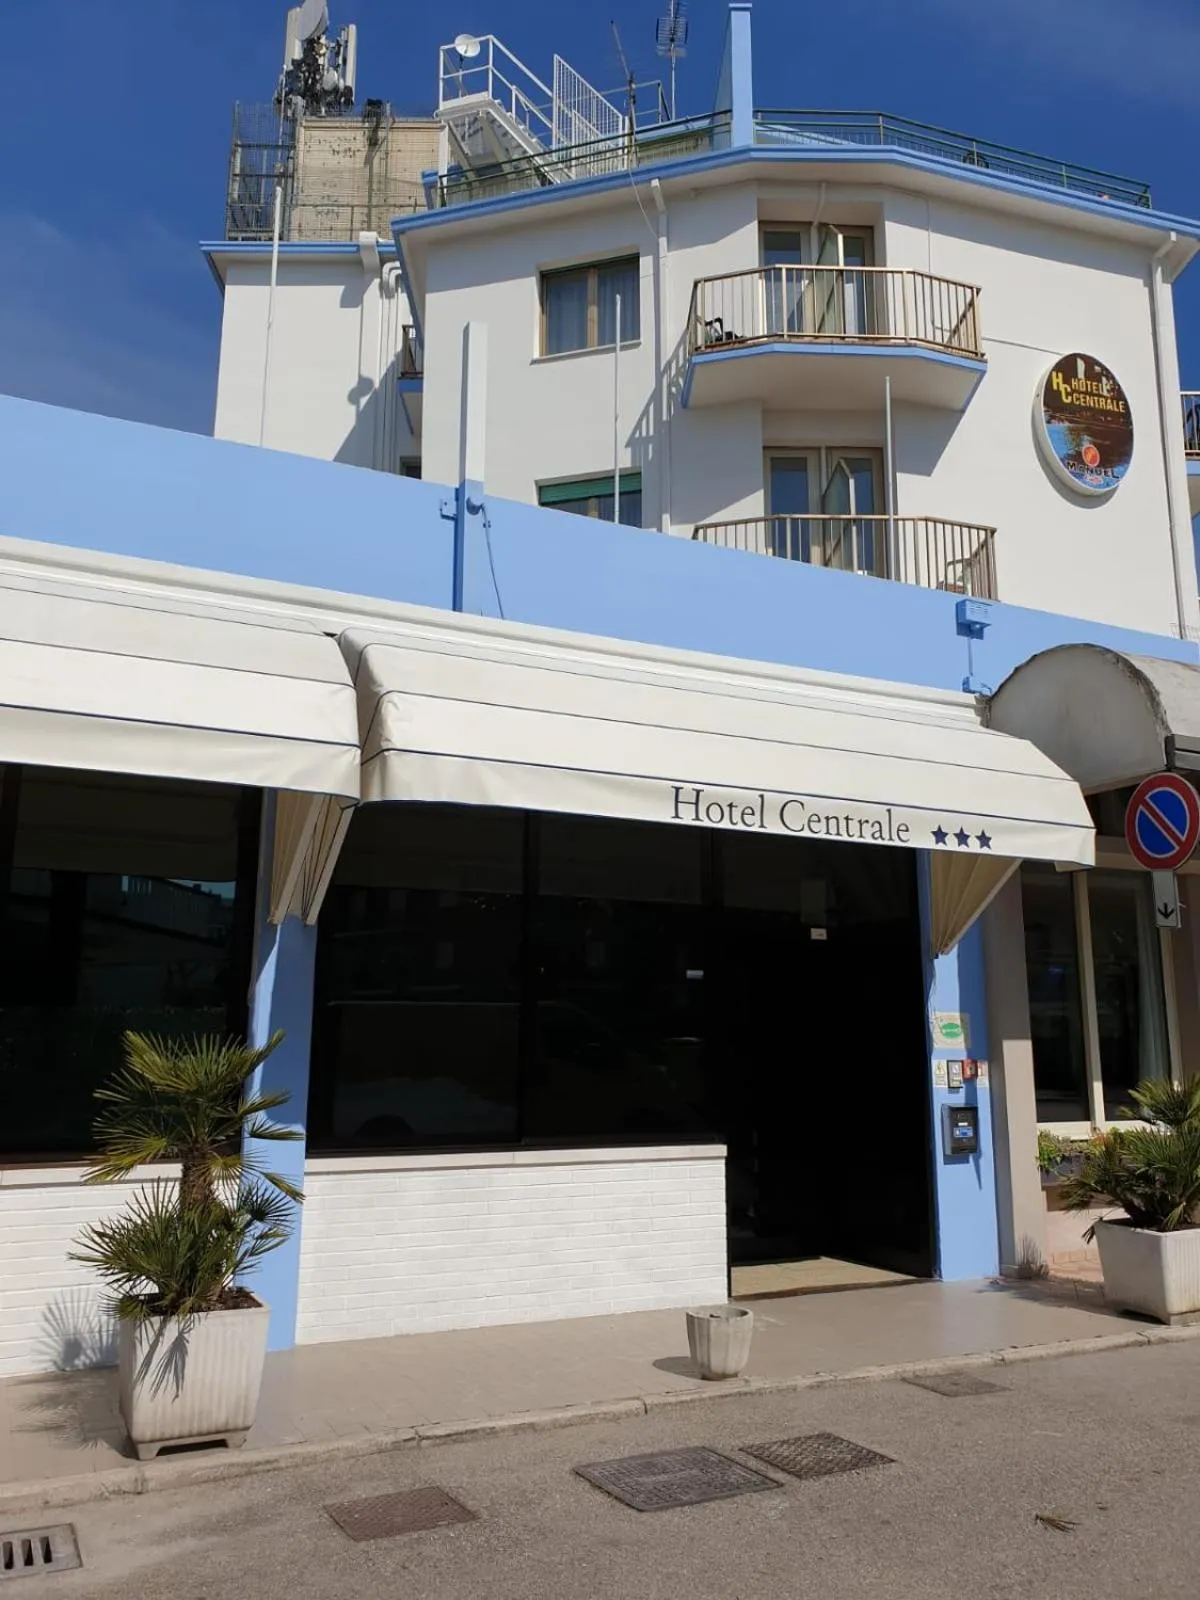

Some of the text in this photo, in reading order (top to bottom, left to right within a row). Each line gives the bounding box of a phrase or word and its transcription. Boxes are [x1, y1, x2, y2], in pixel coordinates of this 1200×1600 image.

[1071, 378, 1105, 394] HOTEL
[1073, 393, 1126, 413] CENTRALE
[670, 785, 910, 843] Hotel Centrale
